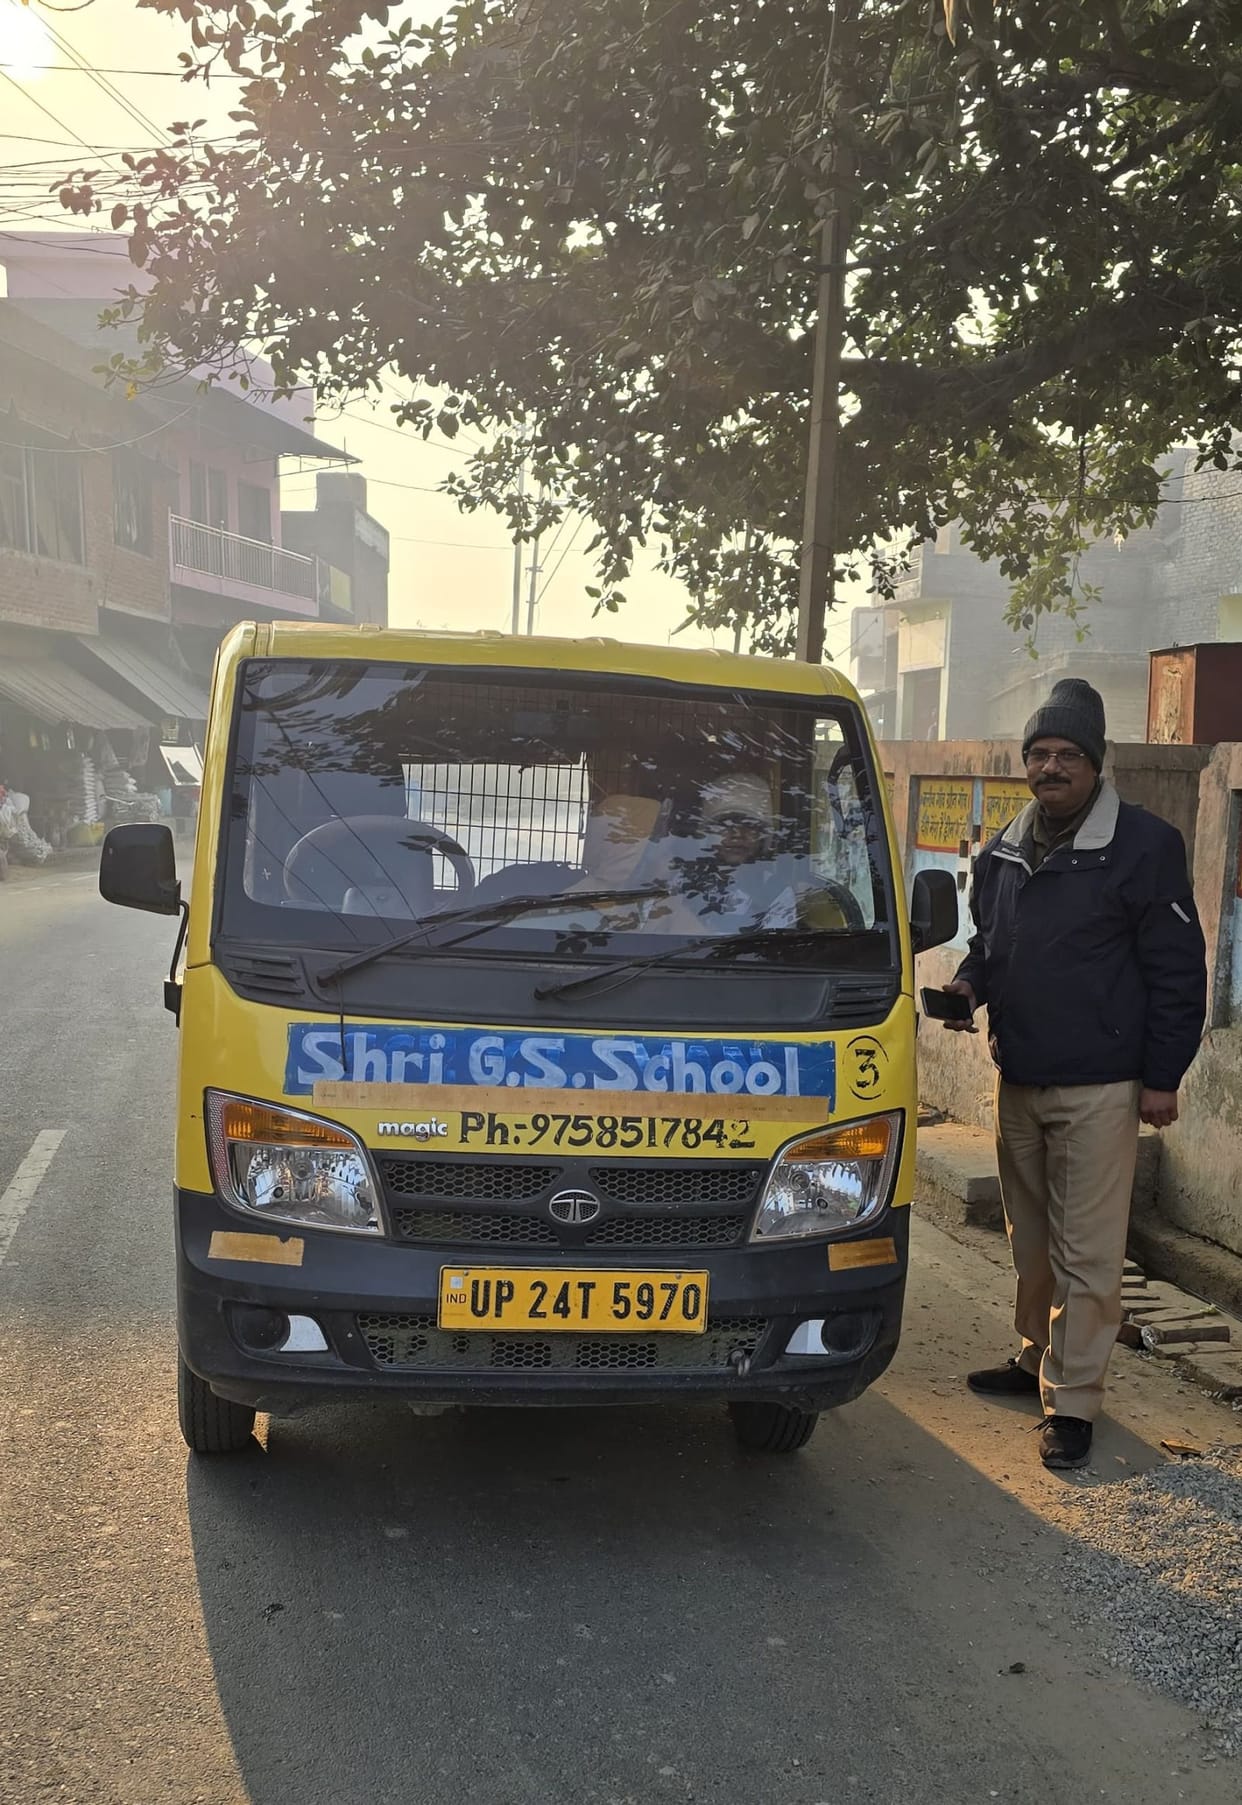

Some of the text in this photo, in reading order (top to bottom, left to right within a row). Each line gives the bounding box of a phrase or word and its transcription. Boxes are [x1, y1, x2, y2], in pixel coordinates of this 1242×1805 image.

[298, 1031, 446, 1086] Shri
[591, 1039, 800, 1097] School
[854, 1047, 880, 1089] 3
[377, 1117, 449, 1142] magic
[445, 1293, 468, 1305] IND
[470, 1279, 702, 1321] UP 24T 5970
